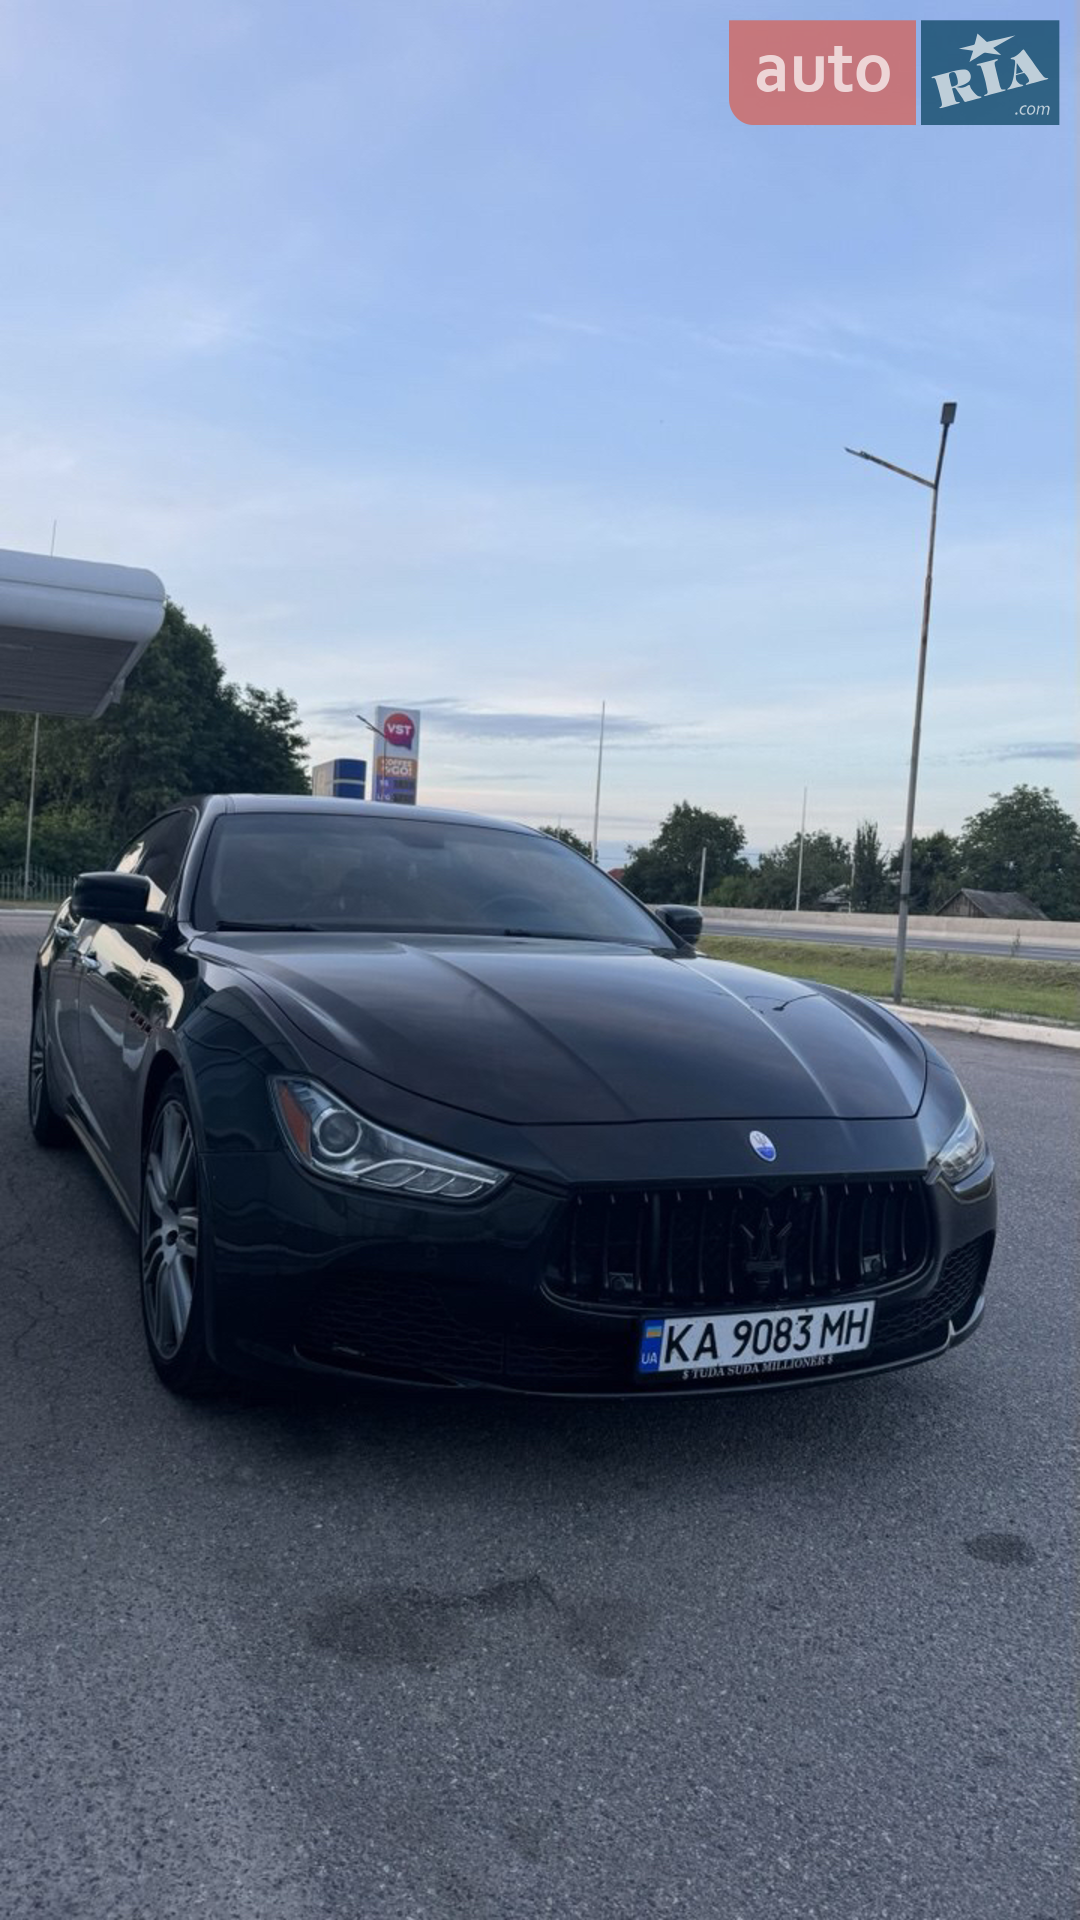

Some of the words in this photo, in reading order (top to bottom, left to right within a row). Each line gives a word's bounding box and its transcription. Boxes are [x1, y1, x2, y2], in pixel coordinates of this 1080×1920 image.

[387, 723, 412, 736] VST
[664, 1322, 718, 1364] KA
[732, 1315, 814, 1358] 9083
[819, 1307, 869, 1349] MH
[641, 1352, 657, 1364] UA
[691, 1366, 725, 1379] TUDA
[727, 1363, 759, 1376] SUDA
[762, 1355, 825, 1372] MILLIONER
